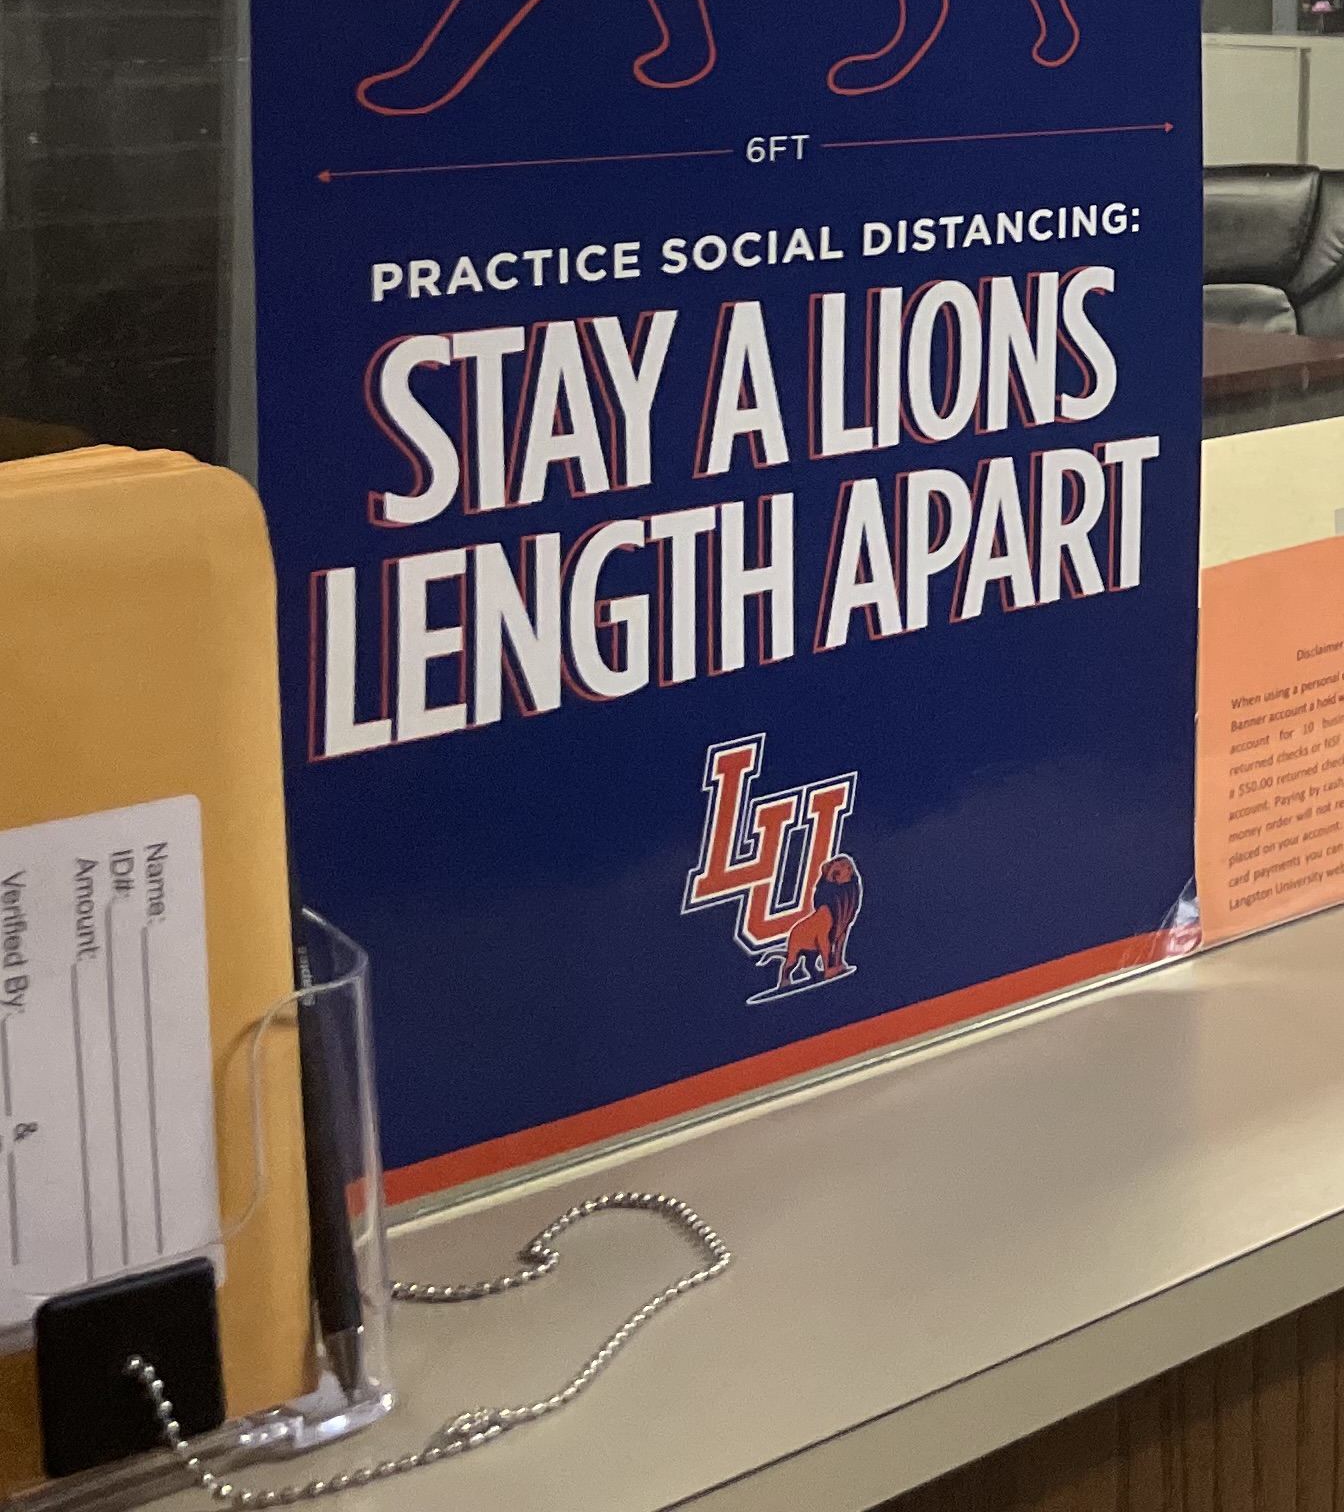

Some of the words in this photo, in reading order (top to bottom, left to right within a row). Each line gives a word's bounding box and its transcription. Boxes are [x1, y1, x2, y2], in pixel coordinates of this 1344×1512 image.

[747, 135, 809, 162] 6FT
[373, 242, 640, 301] PRACTICE
[662, 227, 843, 273] SOCIAL
[863, 203, 1139, 255] DISTANCING:
[365, 310, 678, 527] STAY
[694, 300, 789, 480] A
[809, 265, 1118, 458] LIONS
[309, 492, 795, 762] LENGTH
[814, 435, 1160, 652] APART
[1296, 640, 1343, 661] Disclaimer
[145, 842, 168, 923] Name:
[682, 733, 857, 956] LU
[1, 870, 28, 967] Verified
[75, 858, 100, 961] Amount:
